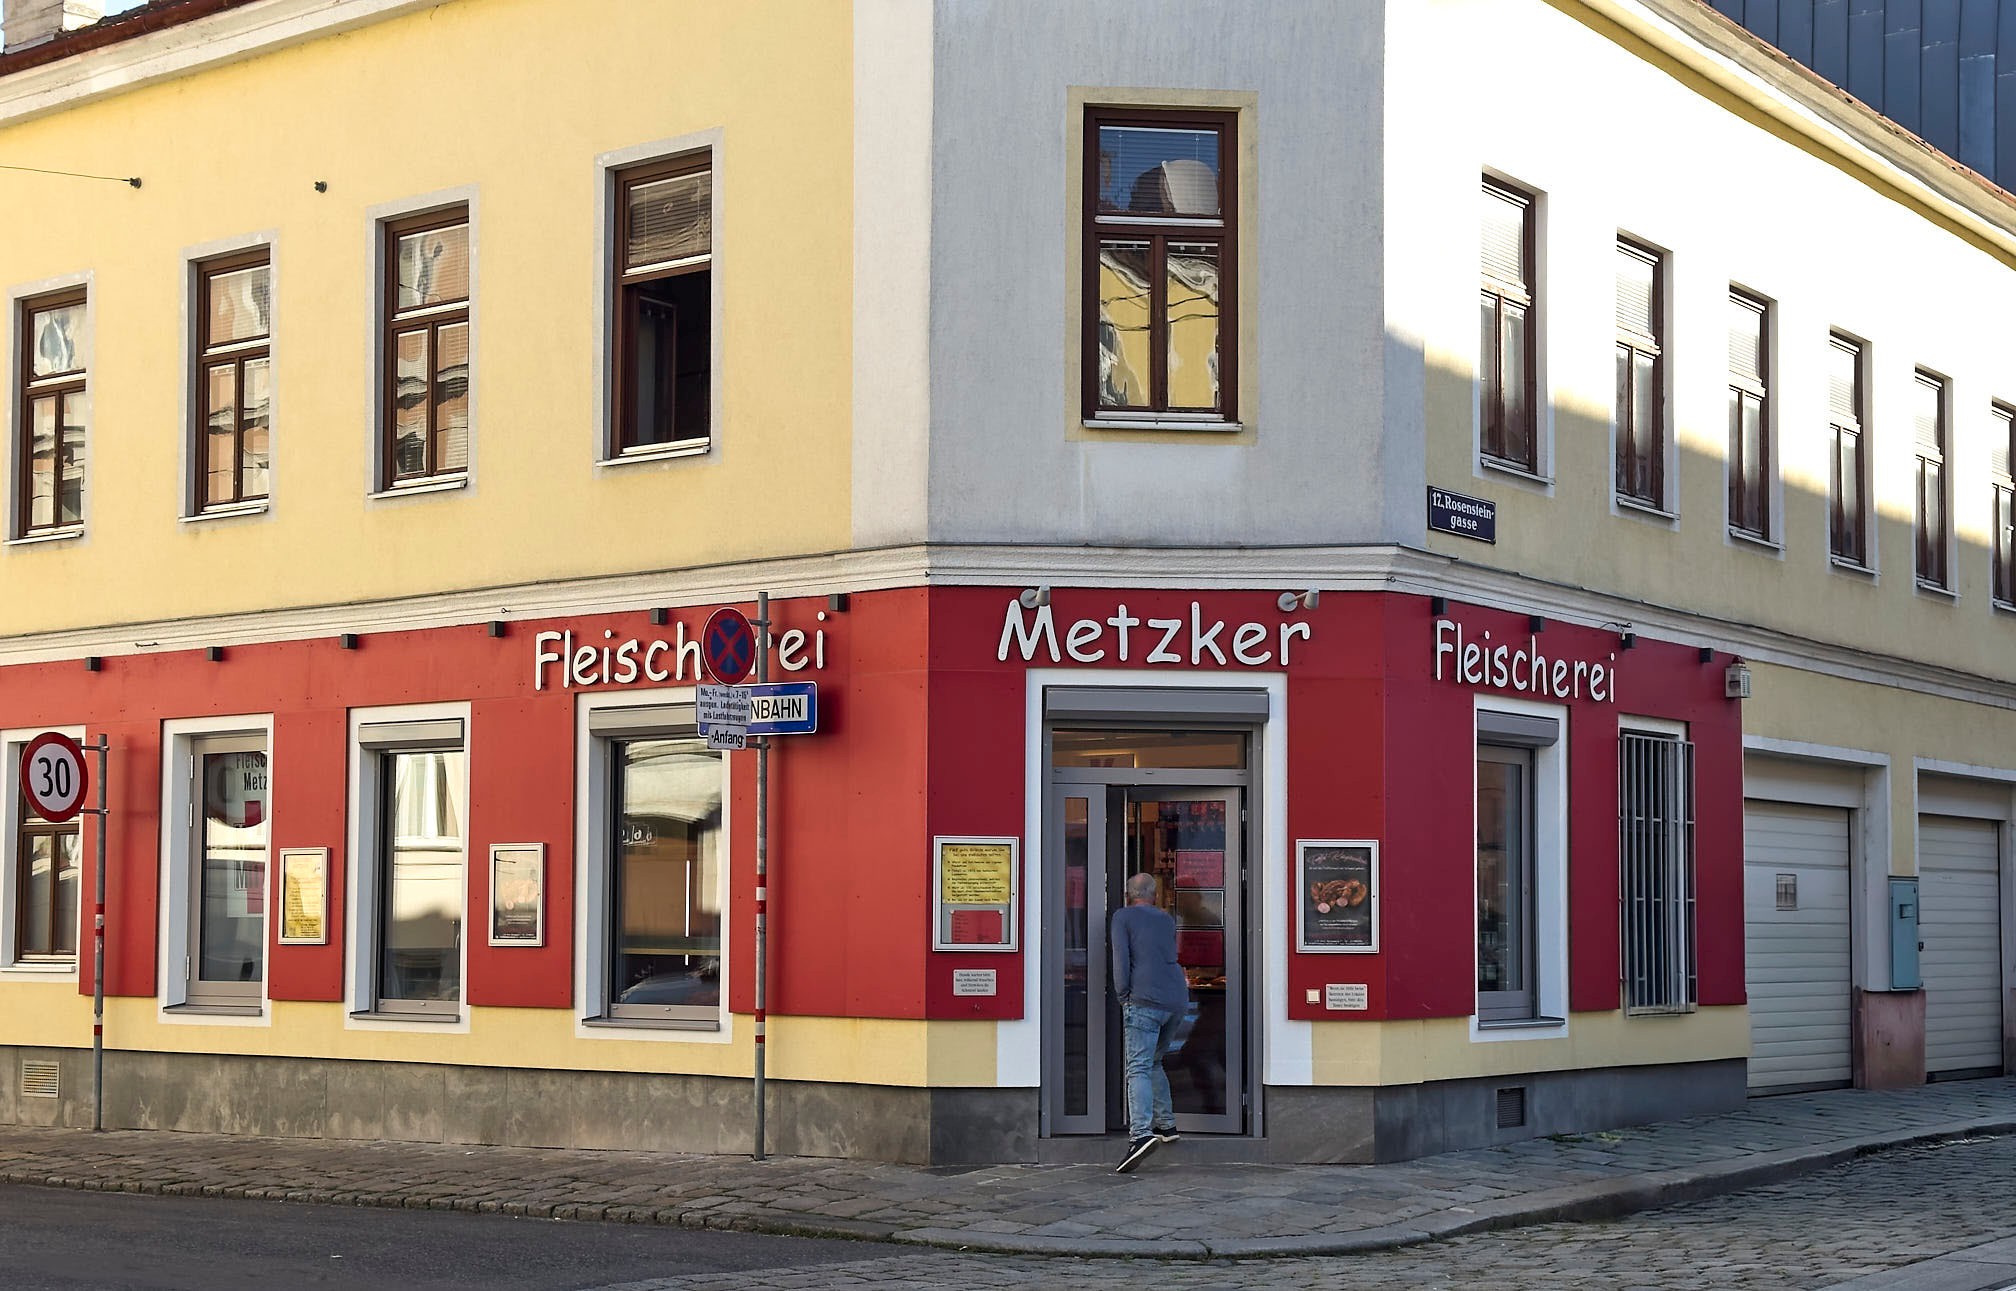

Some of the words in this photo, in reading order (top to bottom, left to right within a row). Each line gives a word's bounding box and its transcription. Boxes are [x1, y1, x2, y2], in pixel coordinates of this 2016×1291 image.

[1450, 515, 1478, 530] gasse
[535, 611, 826, 691] Fleischei
[997, 599, 1310, 666] Metzker
[1436, 619, 1615, 703] Fleischerei
[37, 757, 71, 798] 30
